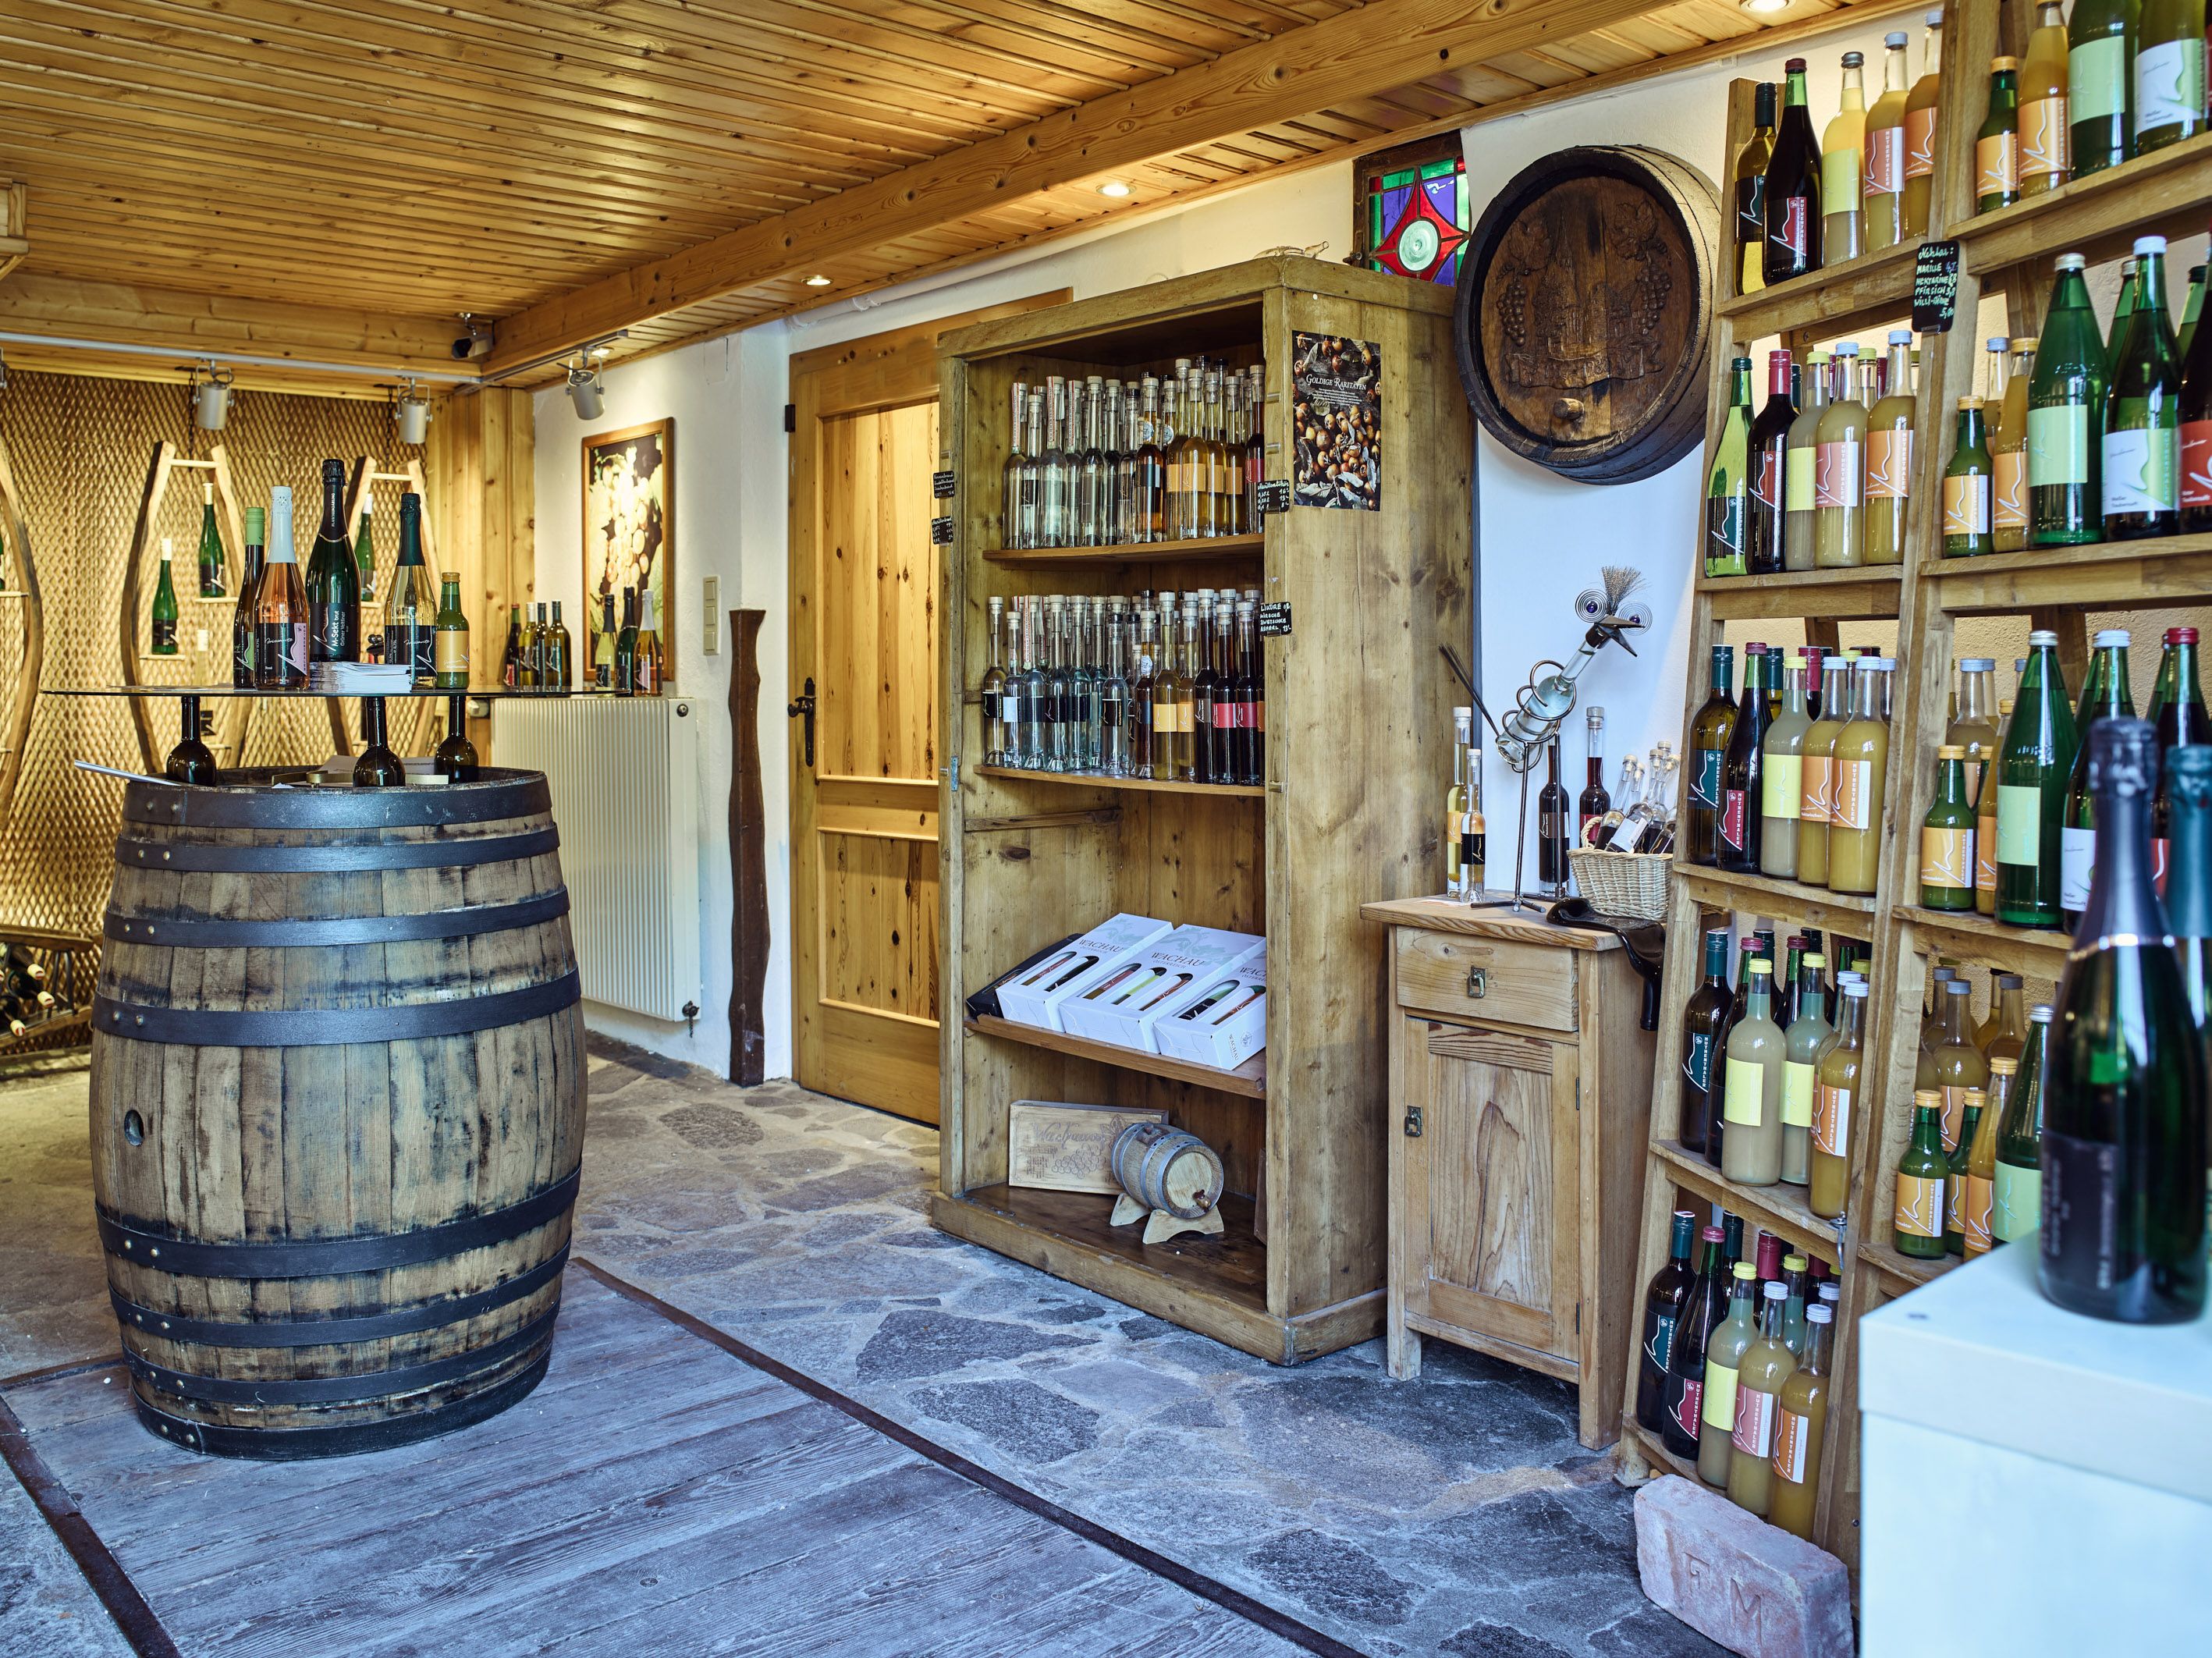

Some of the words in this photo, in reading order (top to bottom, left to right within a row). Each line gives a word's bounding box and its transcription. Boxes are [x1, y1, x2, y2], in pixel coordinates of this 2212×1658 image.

[1078, 939, 1124, 953] WACHAU
[1151, 952, 1205, 967] WACHAU
[1665, 1320, 1674, 1369] MUTHENTHALER
[1692, 1384, 1700, 1436] MUTHENTHALER
[1752, 1394, 1760, 1449] MUTHENTHALER
[1786, 1415, 1795, 1474] MUTHENTHALER
